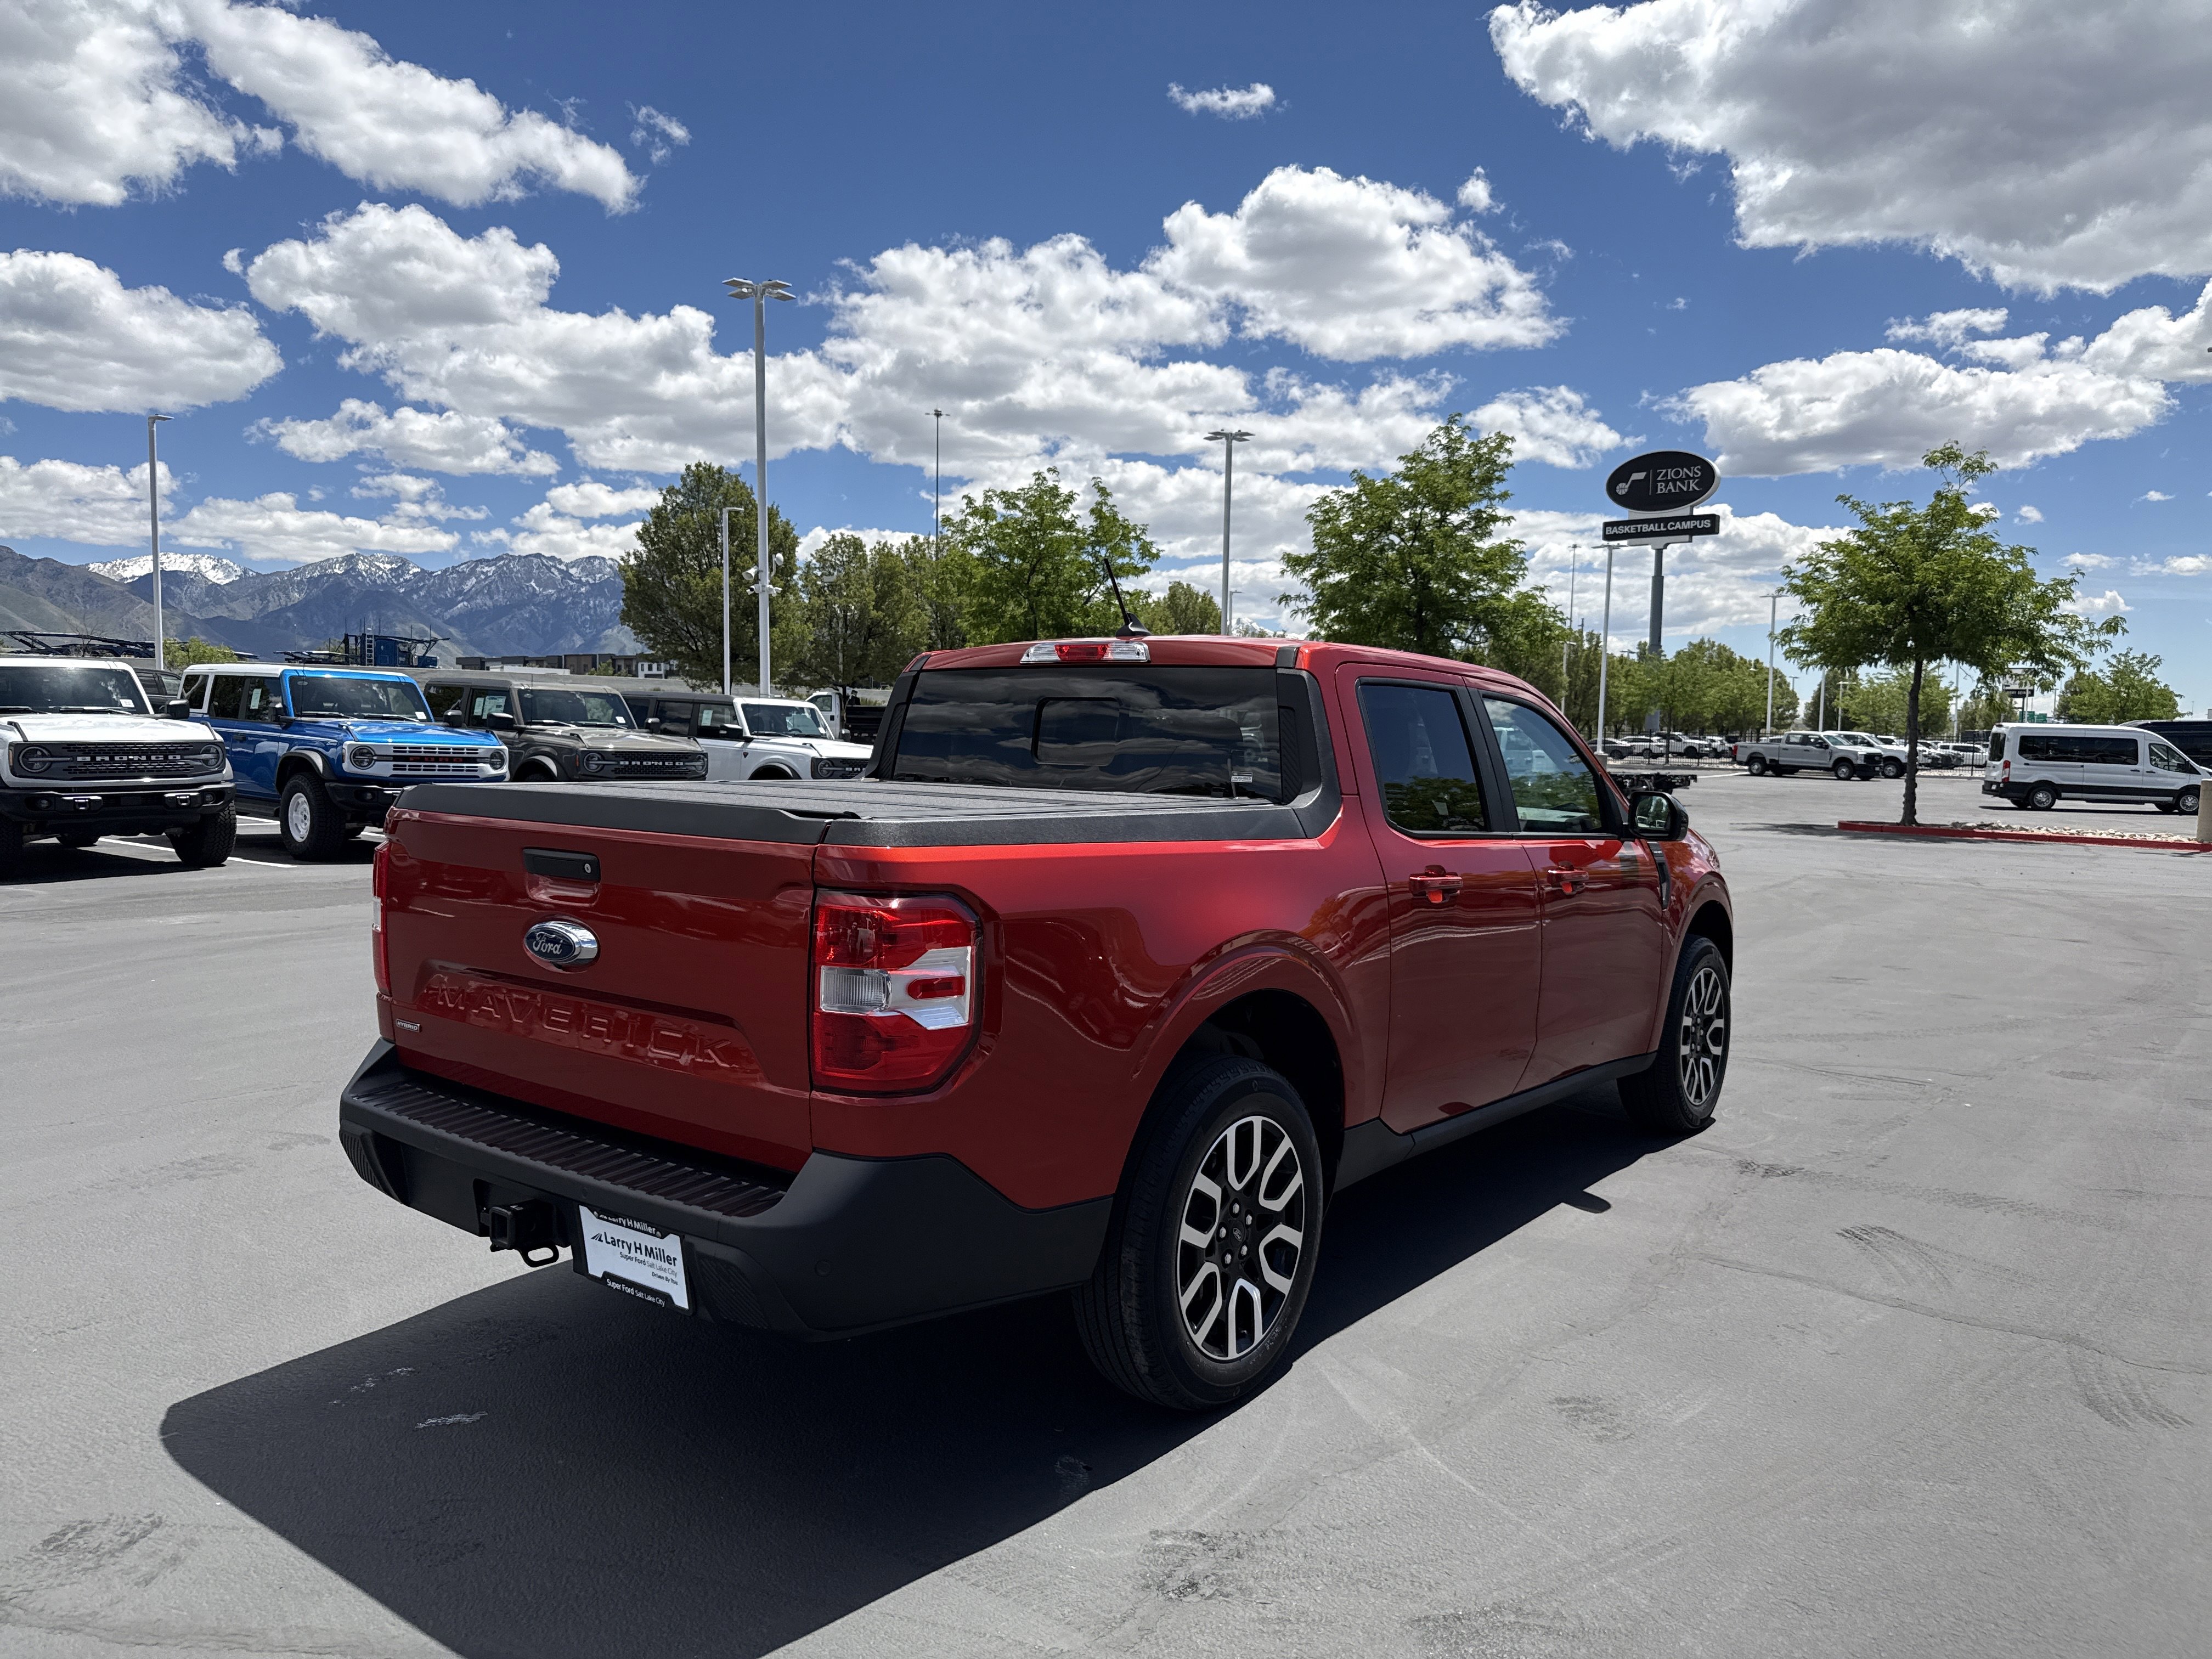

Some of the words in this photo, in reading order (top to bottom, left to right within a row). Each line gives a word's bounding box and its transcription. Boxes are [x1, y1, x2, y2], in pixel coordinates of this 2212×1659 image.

[1656, 466, 1701, 481] ZIONS
[1656, 479, 1702, 494] BANK
[1605, 523, 1666, 535] BASKETBALL
[1667, 520, 1711, 531] CAMPUS
[532, 932, 562, 955] Ford
[397, 1020, 418, 1031] HYBRID
[430, 984, 735, 1069] MAVERICK
[627, 1218, 634, 1228] H
[634, 1220, 656, 1234] Miller
[604, 1232, 631, 1254] Larry
[634, 1241, 643, 1255] H
[645, 1245, 677, 1267] Miller
[620, 1251, 634, 1262] Super
[635, 1257, 646, 1266] Ford
[646, 1260, 656, 1269] Salt
[656, 1263, 667, 1273] Lake
[668, 1267, 677, 1278] City
[607, 1278, 621, 1290] Super
[622, 1284, 634, 1295] Ford
[635, 1289, 645, 1299] Salt
[645, 1293, 656, 1302] Lake
[656, 1296, 665, 1307] City
